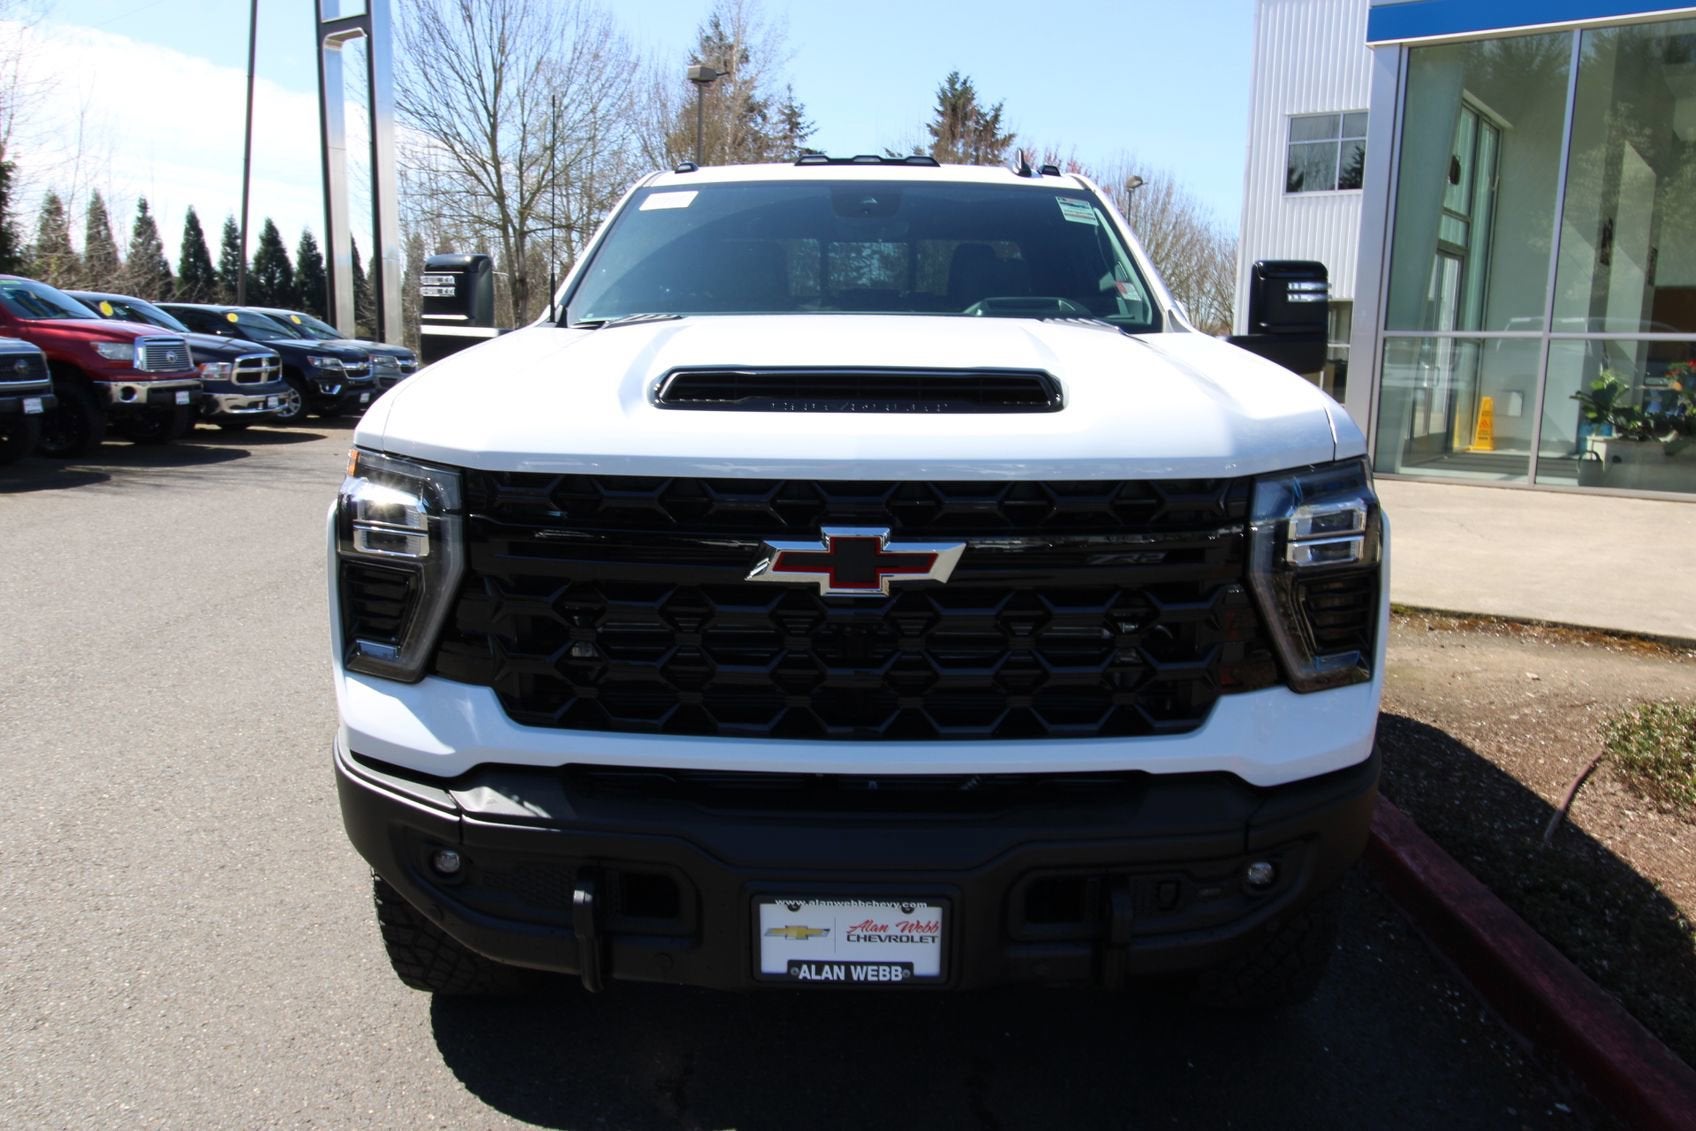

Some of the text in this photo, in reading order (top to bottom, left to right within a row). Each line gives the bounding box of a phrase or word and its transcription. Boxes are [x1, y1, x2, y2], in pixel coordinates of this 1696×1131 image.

[775, 900, 928, 909] www.alanwebbchevy.com
[847, 919, 940, 934] Alan Webb
[847, 934, 939, 944] CHEVROLET
[798, 964, 903, 981] ALAN WEBB
